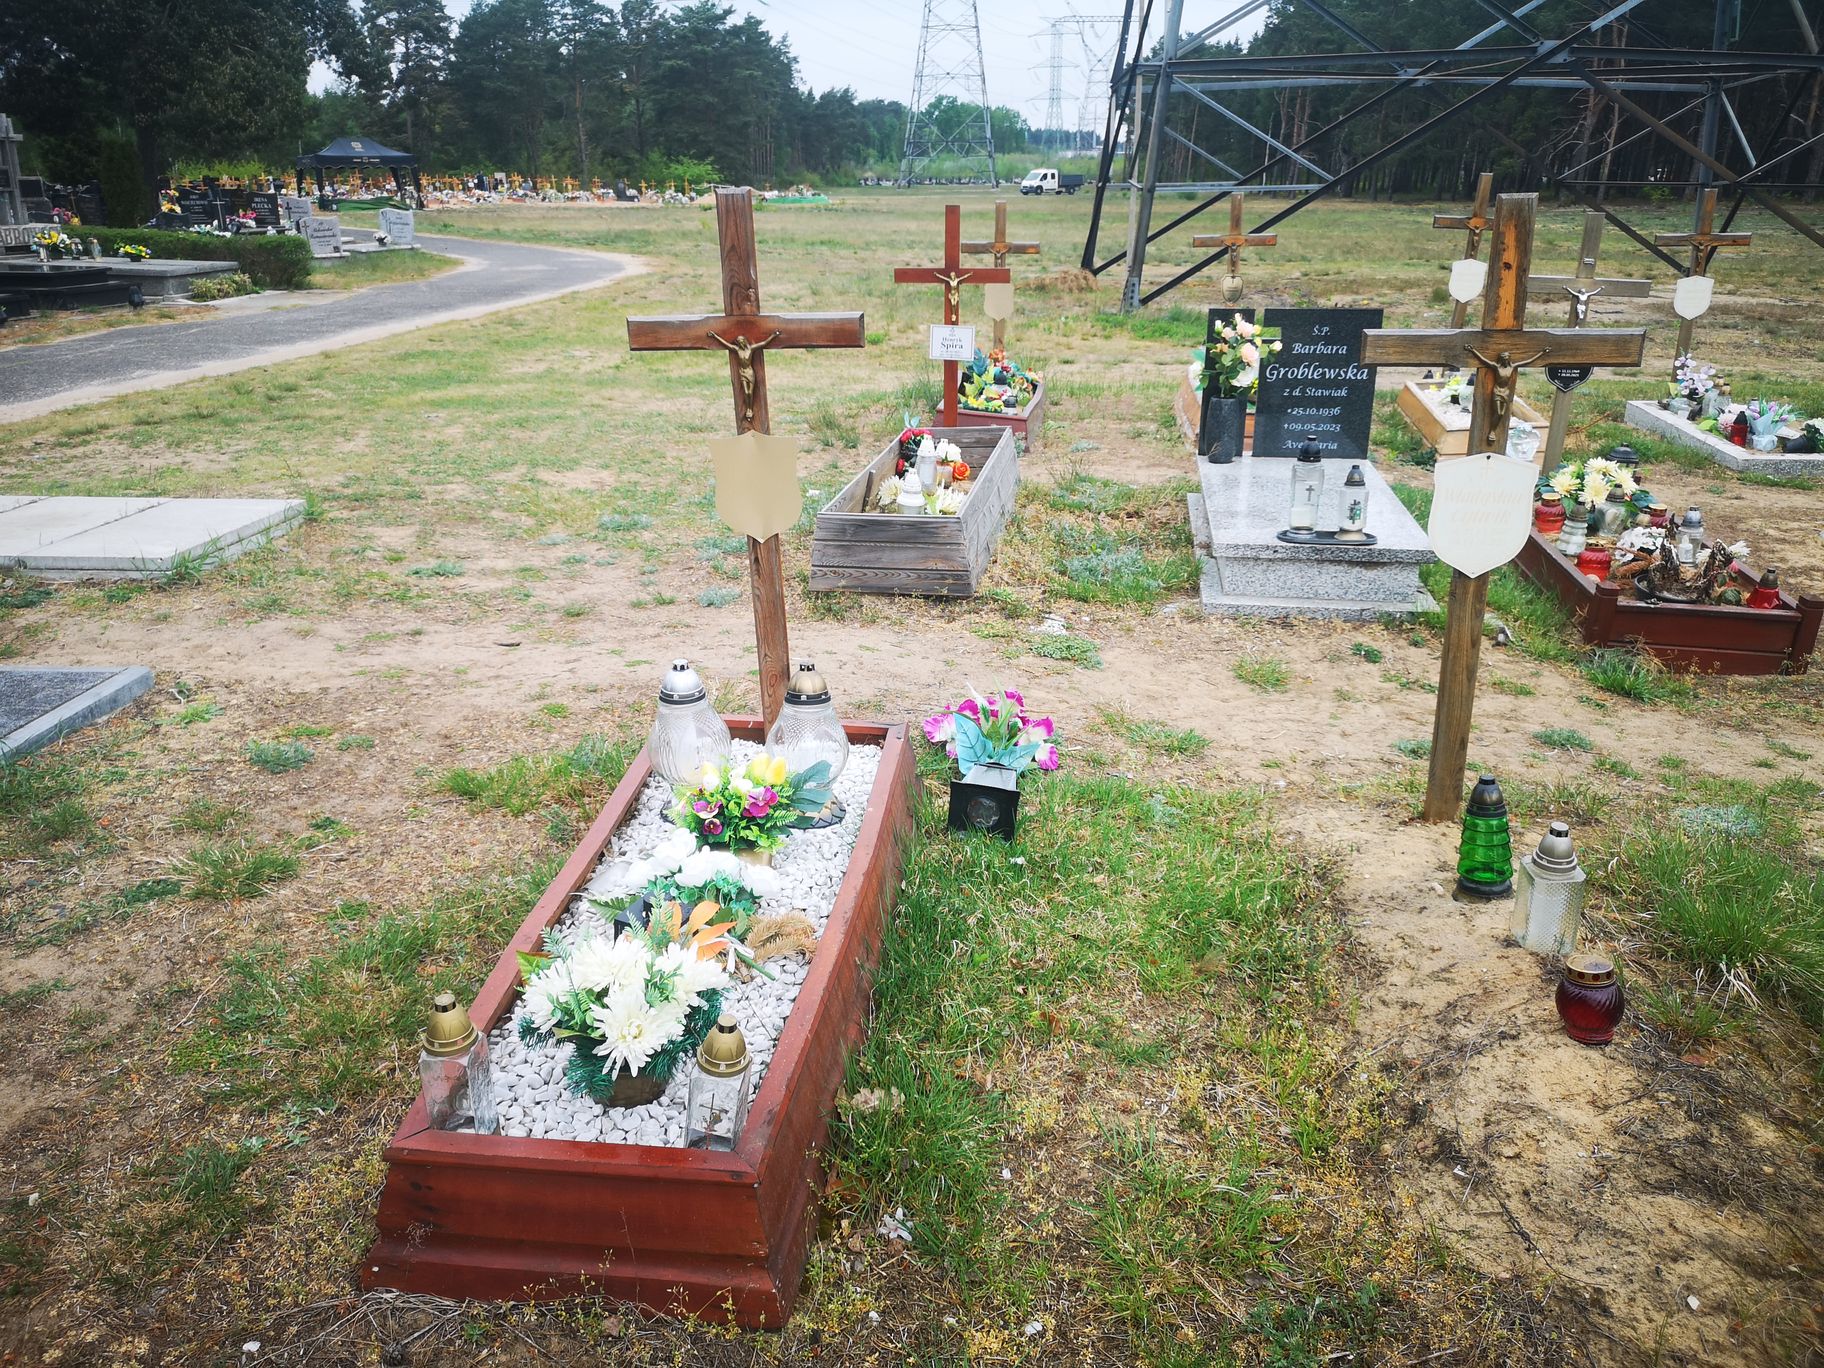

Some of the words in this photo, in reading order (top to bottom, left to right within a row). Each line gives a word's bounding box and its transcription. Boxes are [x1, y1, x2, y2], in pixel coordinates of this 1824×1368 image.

[1312, 325, 1331, 336] Ś.P.
[941, 342, 963, 350] Spira
[1292, 341, 1347, 354] Barbara
[1266, 362, 1369, 381] Groblewska
[1305, 387, 1348, 397] Stawiak
[1282, 440, 1304, 449] Ave
